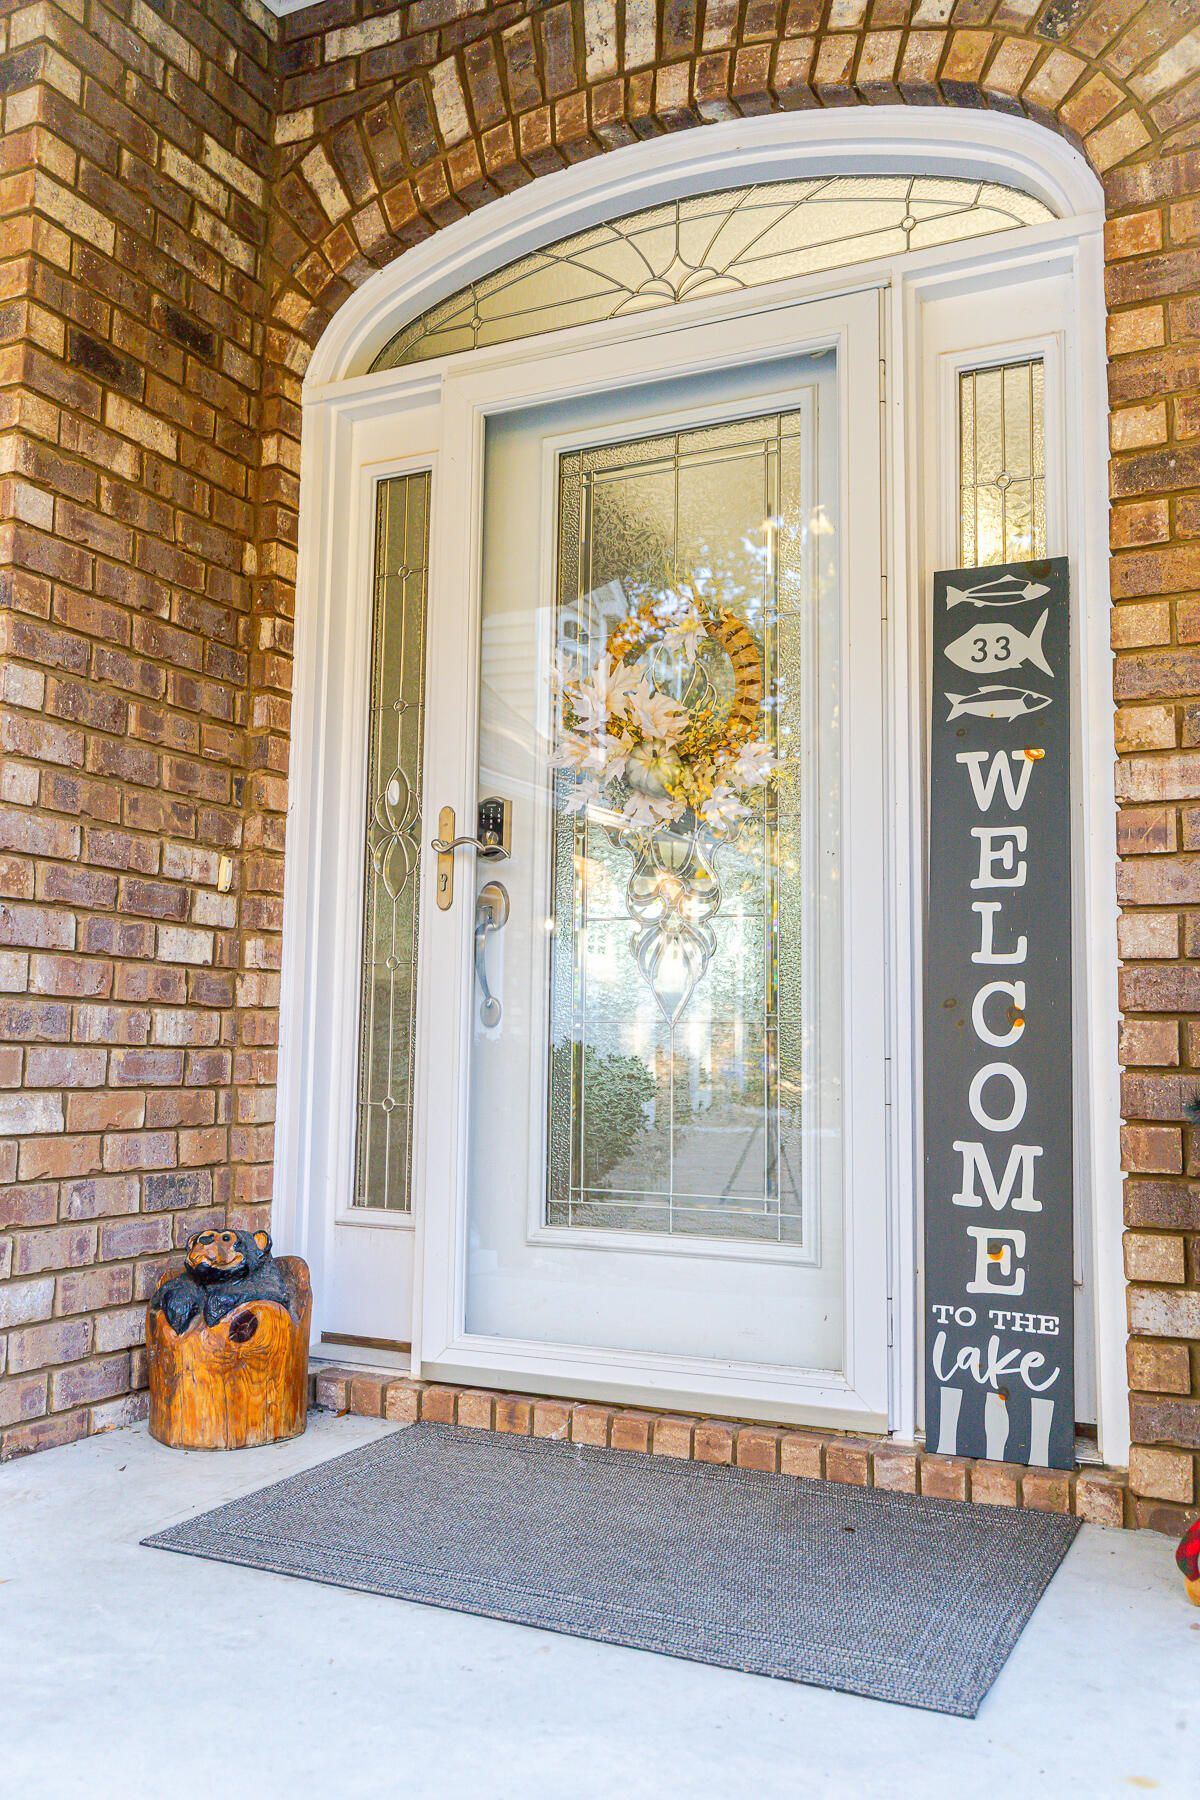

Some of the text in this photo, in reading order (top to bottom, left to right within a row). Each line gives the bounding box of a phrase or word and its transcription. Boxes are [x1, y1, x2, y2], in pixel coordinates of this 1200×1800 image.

[970, 635, 1012, 663] 33
[951, 748, 1046, 1297] WELCOME
[931, 1304, 1061, 1336] TO THE
[932, 1330, 1061, 1392] lake
